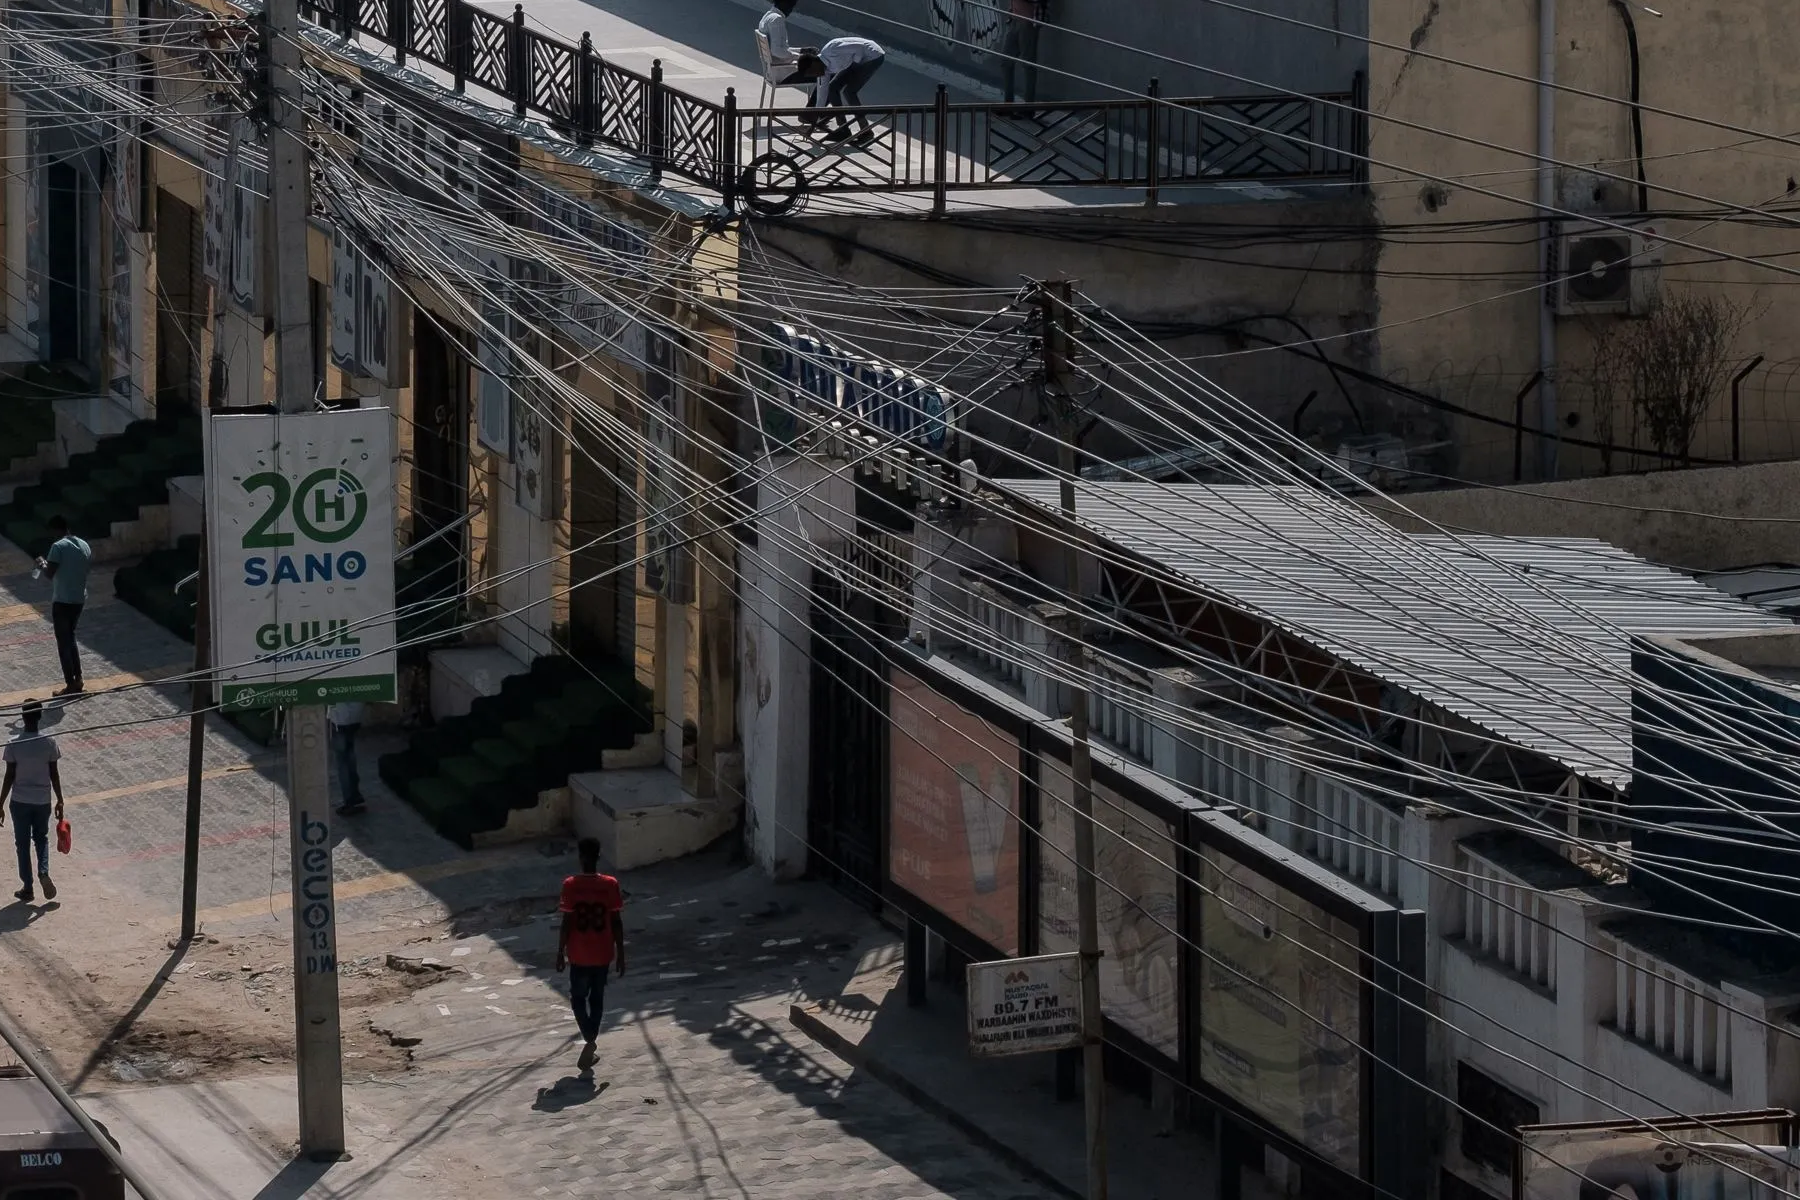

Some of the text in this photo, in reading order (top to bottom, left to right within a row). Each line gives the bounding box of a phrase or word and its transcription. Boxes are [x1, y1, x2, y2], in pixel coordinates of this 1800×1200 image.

[240, 467, 368, 550] 20
[243, 550, 367, 587] SANO
[255, 619, 361, 651] GUUL
[300, 810, 329, 930] beco
[993, 995, 1058, 1015] 89.7 FM
[20, 1151, 63, 1168] BELCO
